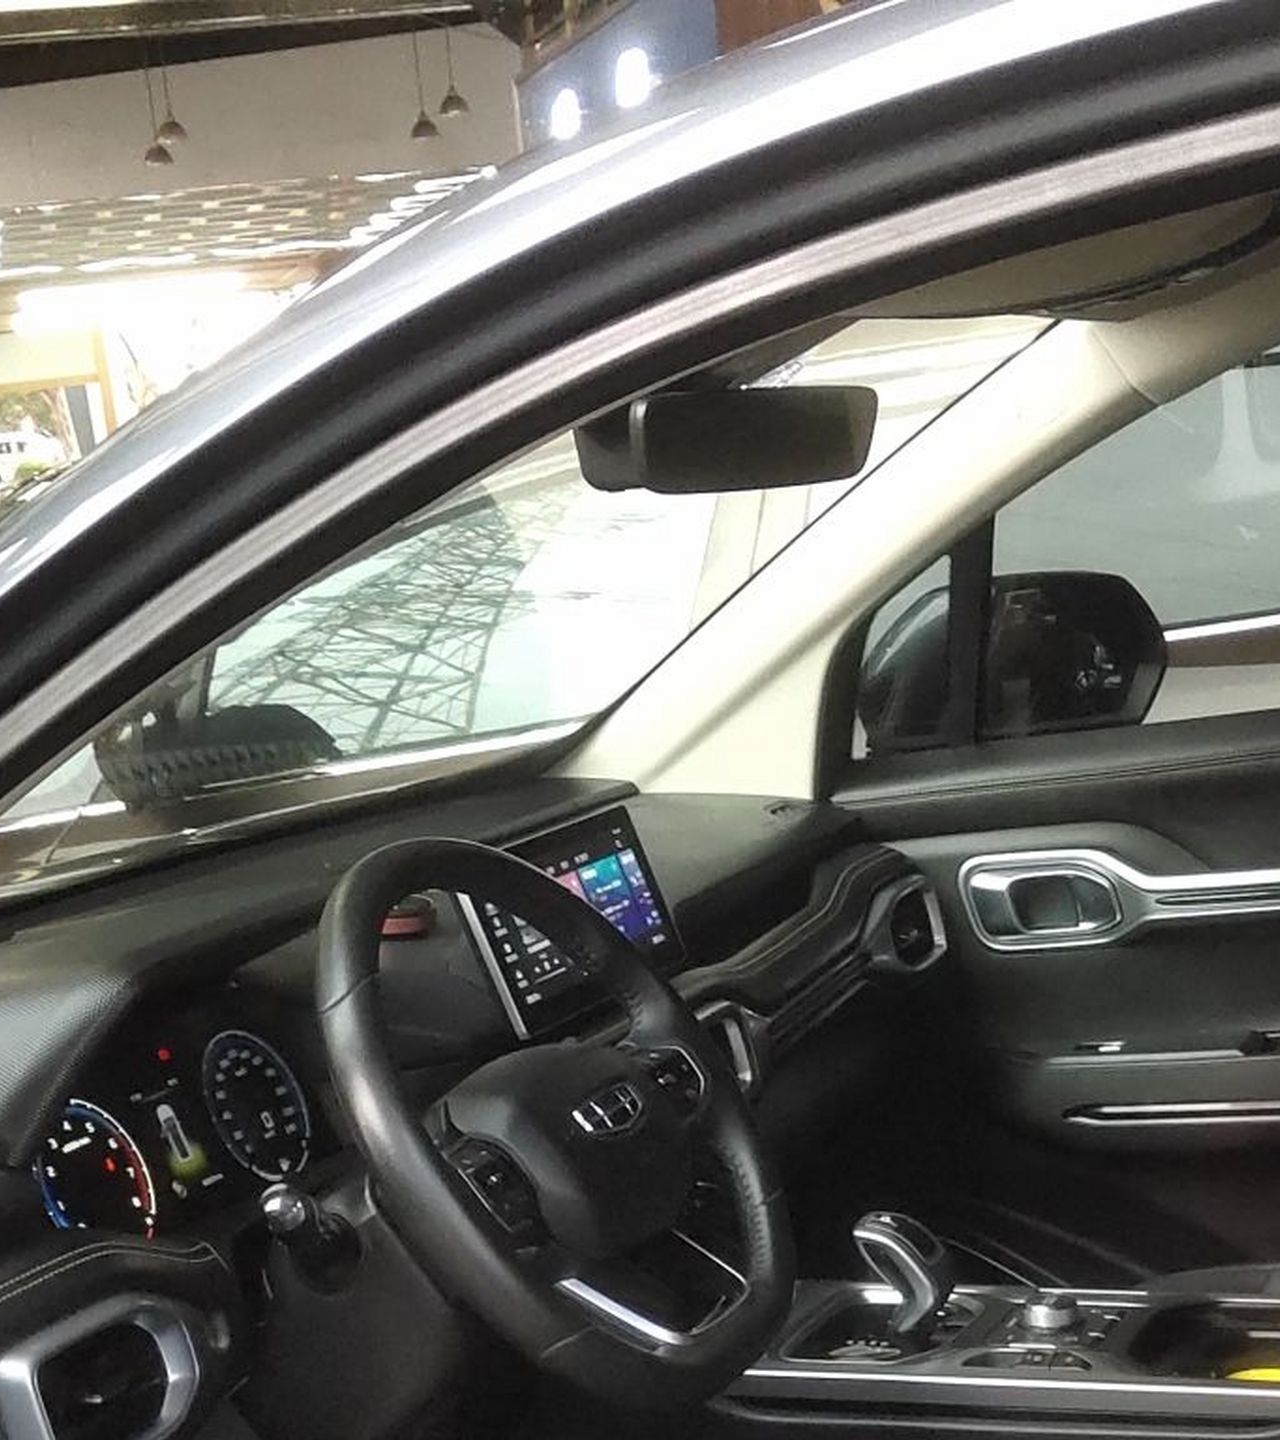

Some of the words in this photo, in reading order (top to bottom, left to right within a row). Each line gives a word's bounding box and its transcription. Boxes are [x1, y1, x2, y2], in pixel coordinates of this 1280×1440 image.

[84, 1121, 95, 1133] 5
[45, 1165, 56, 1177] 2
[125, 1166, 135, 1178] 7
